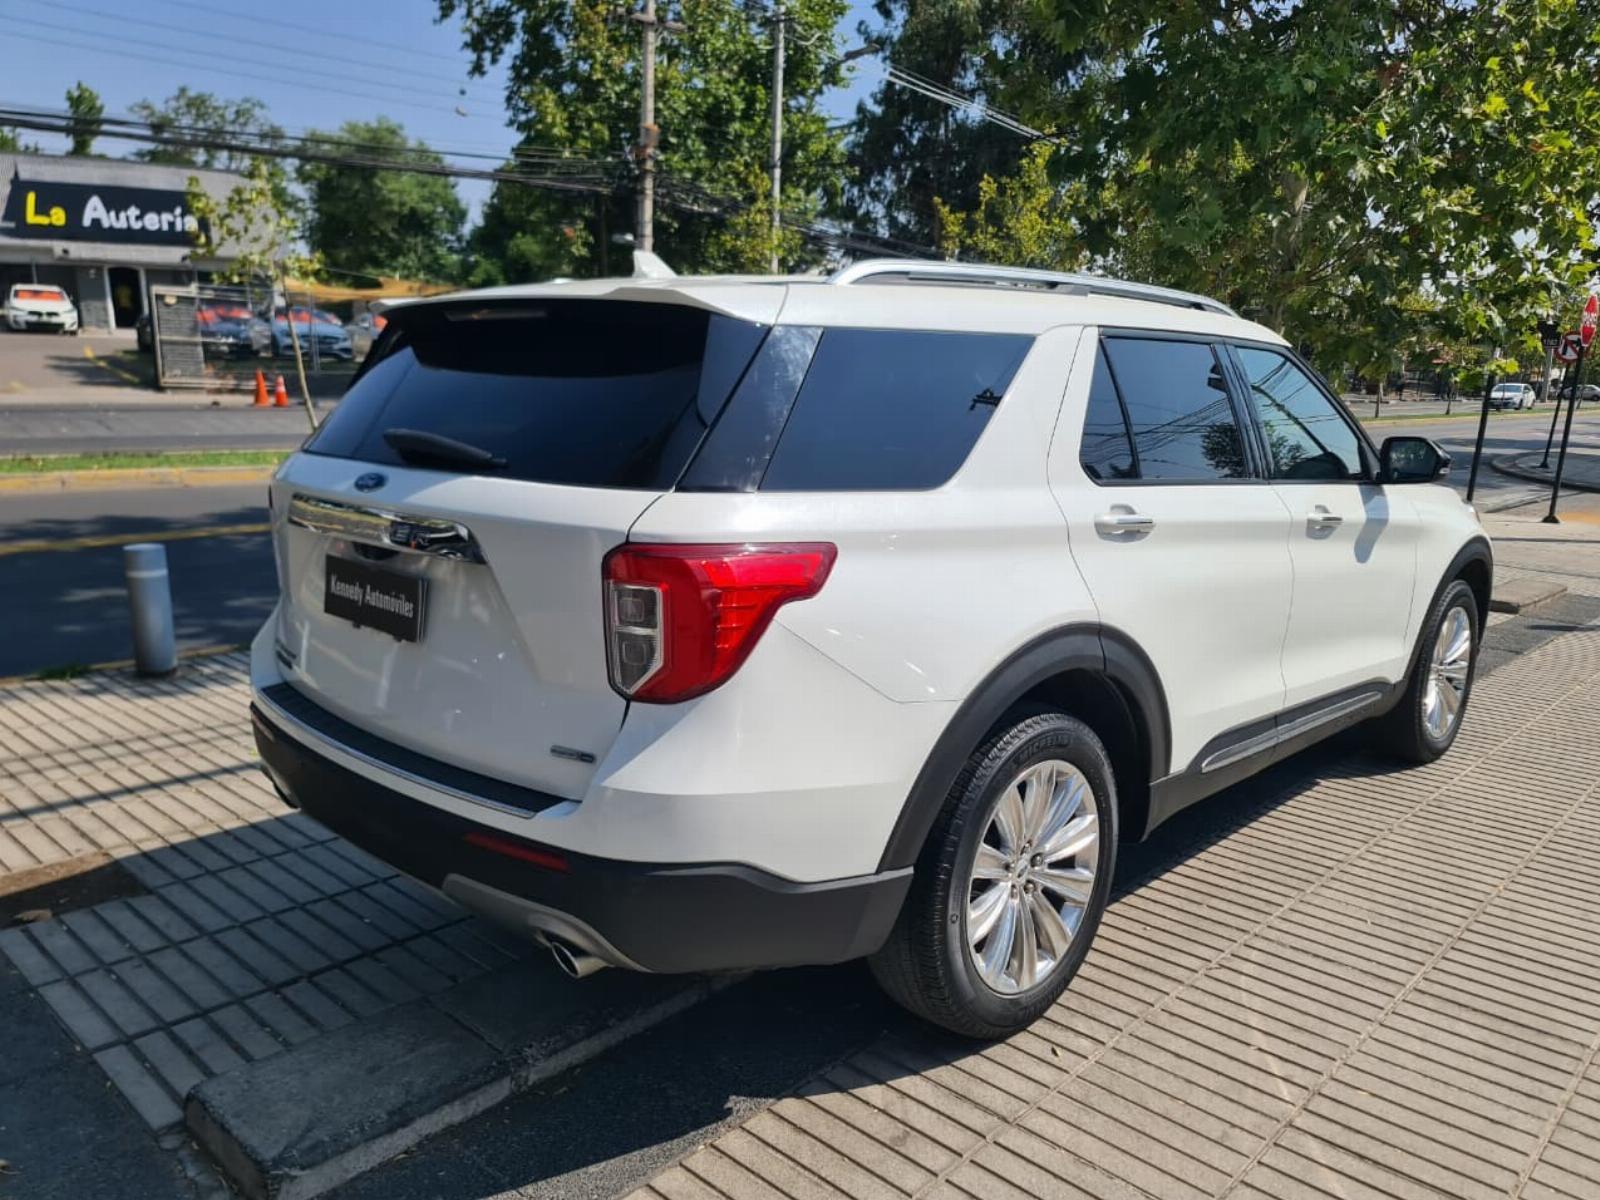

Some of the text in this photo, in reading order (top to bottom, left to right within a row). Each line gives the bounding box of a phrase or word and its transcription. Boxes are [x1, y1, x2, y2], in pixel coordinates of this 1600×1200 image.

[25, 191, 66, 226] La
[331, 574, 414, 618] Kennedy Automóviles
